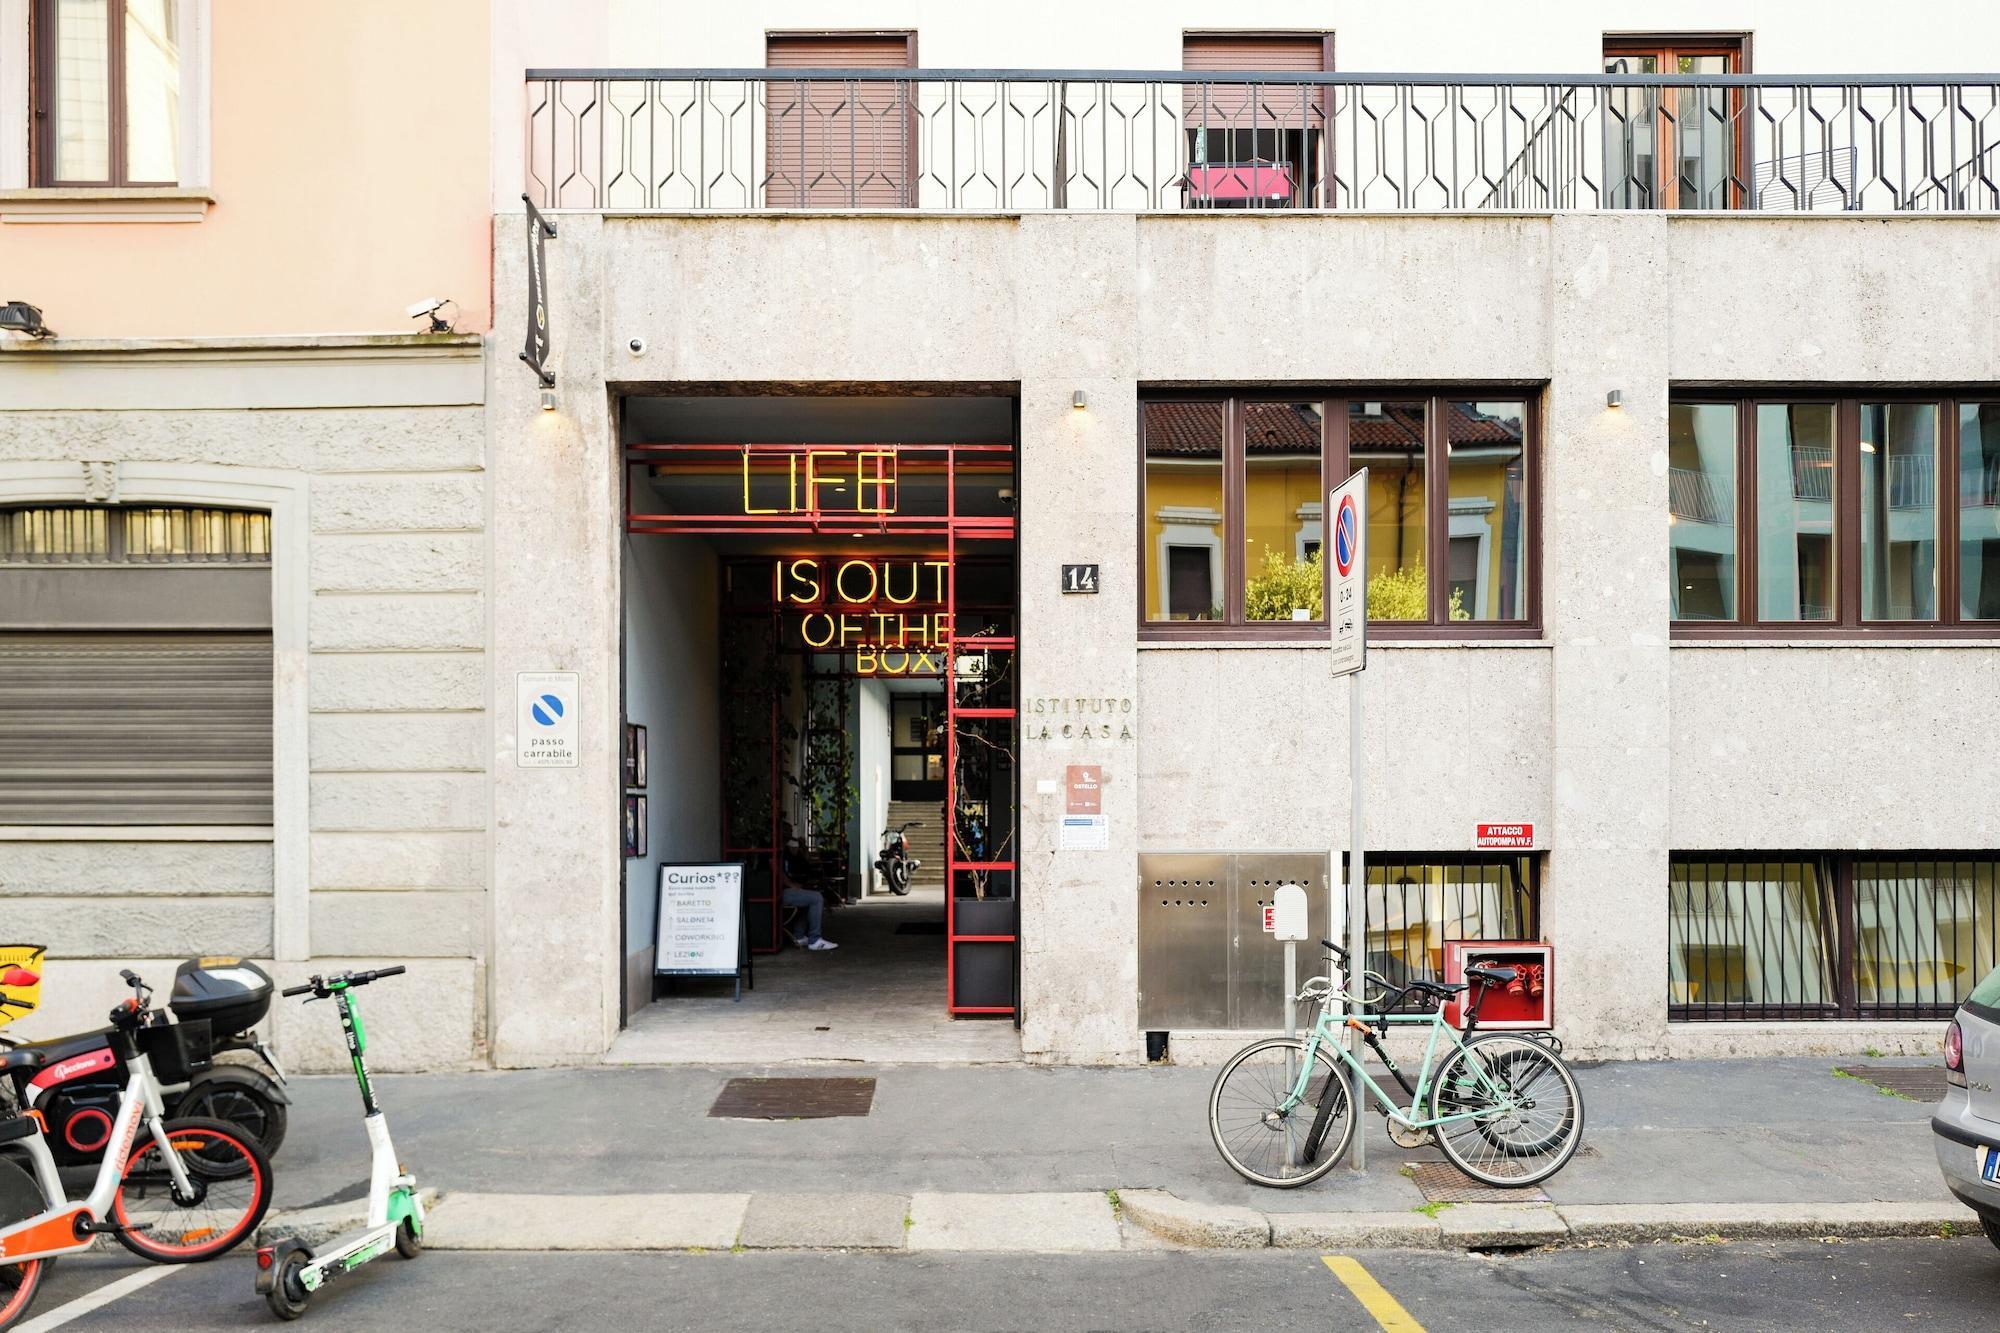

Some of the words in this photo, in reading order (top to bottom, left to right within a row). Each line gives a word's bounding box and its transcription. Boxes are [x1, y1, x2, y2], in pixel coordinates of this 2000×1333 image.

[743, 451, 897, 514] LIFE
[776, 559, 820, 604] IS
[836, 559, 954, 604] OUT
[1068, 567, 1094, 590] 14
[801, 613, 863, 648] OF
[869, 613, 955, 648] THE
[856, 644, 937, 674] BOX
[1026, 698, 1132, 714] ISTITUTO
[1026, 724, 1053, 740] LA
[1062, 724, 1133, 740] CASA
[531, 738, 564, 747] passo
[523, 749, 572, 758] carrabile
[1487, 827, 1522, 835] ATTACCO
[1478, 837, 1516, 846] AUTOPOMPA
[676, 899, 712, 907] BARETTO
[115, 1100, 145, 1171] ridemovi
